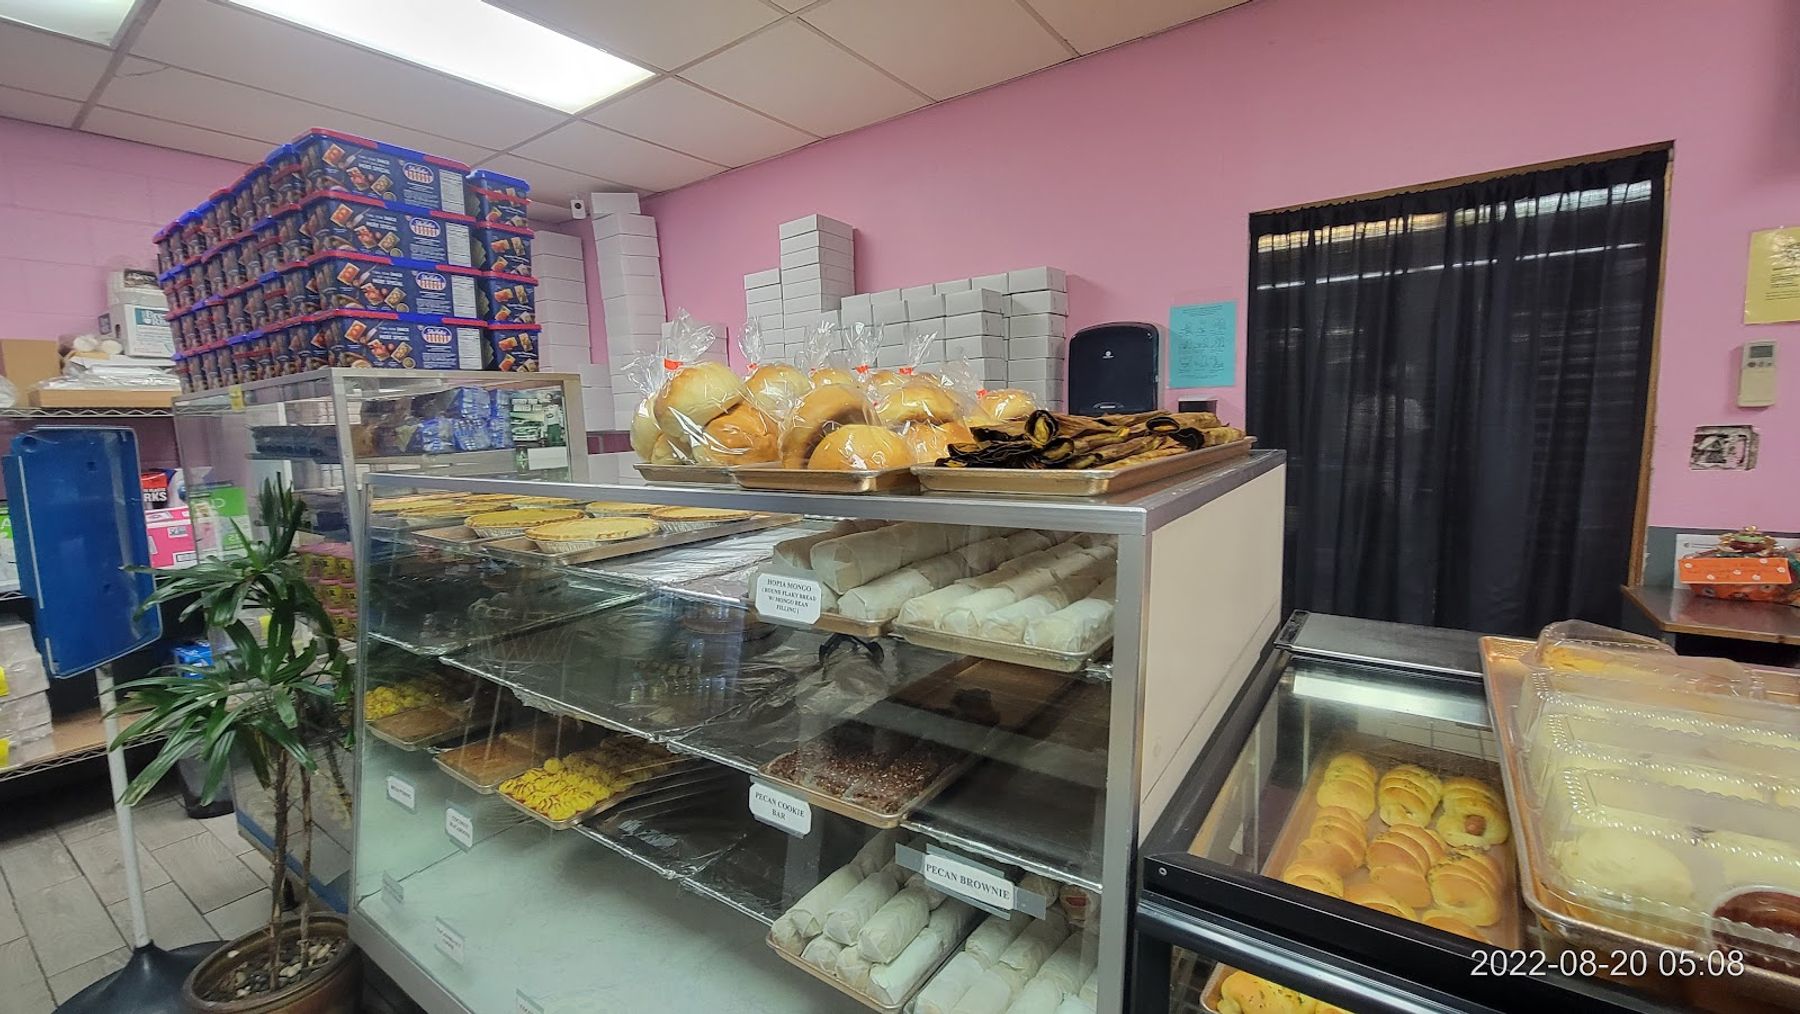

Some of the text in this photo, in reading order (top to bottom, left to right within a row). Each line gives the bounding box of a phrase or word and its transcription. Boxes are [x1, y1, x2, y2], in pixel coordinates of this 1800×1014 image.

[143, 492, 167, 502] RKS
[767, 578, 812, 592] HOPIA MONGO
[755, 791, 805, 818] PECAN COOKIE
[772, 808, 786, 820] BAR
[926, 863, 1010, 900] PECAN BROWNIE
